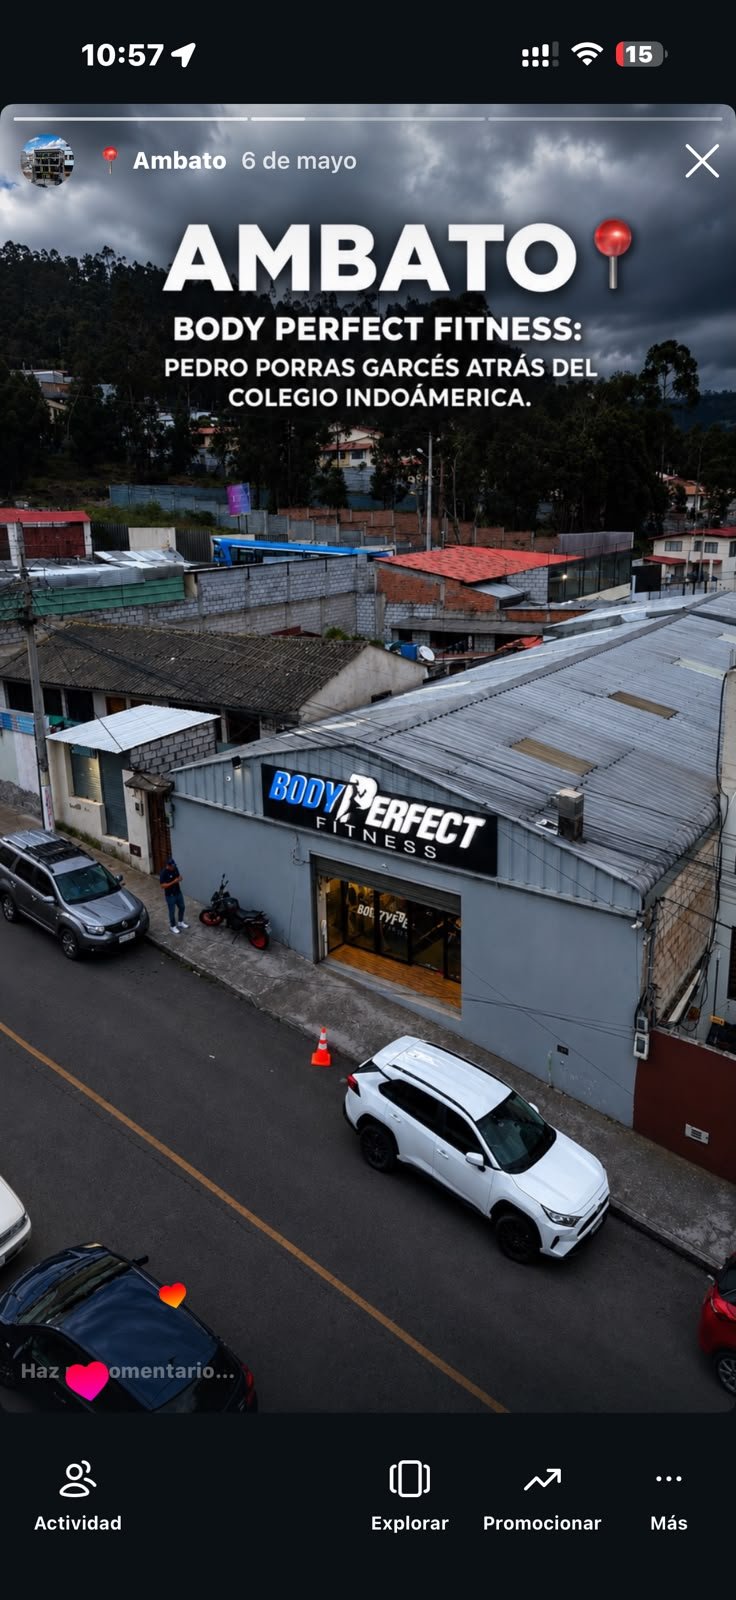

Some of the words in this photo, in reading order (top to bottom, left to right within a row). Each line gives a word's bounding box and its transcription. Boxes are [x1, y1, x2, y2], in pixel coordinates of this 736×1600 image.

[268, 771, 346, 814] BODY
[336, 774, 486, 849] PERFECT
[316, 816, 437, 859] FITNESS
